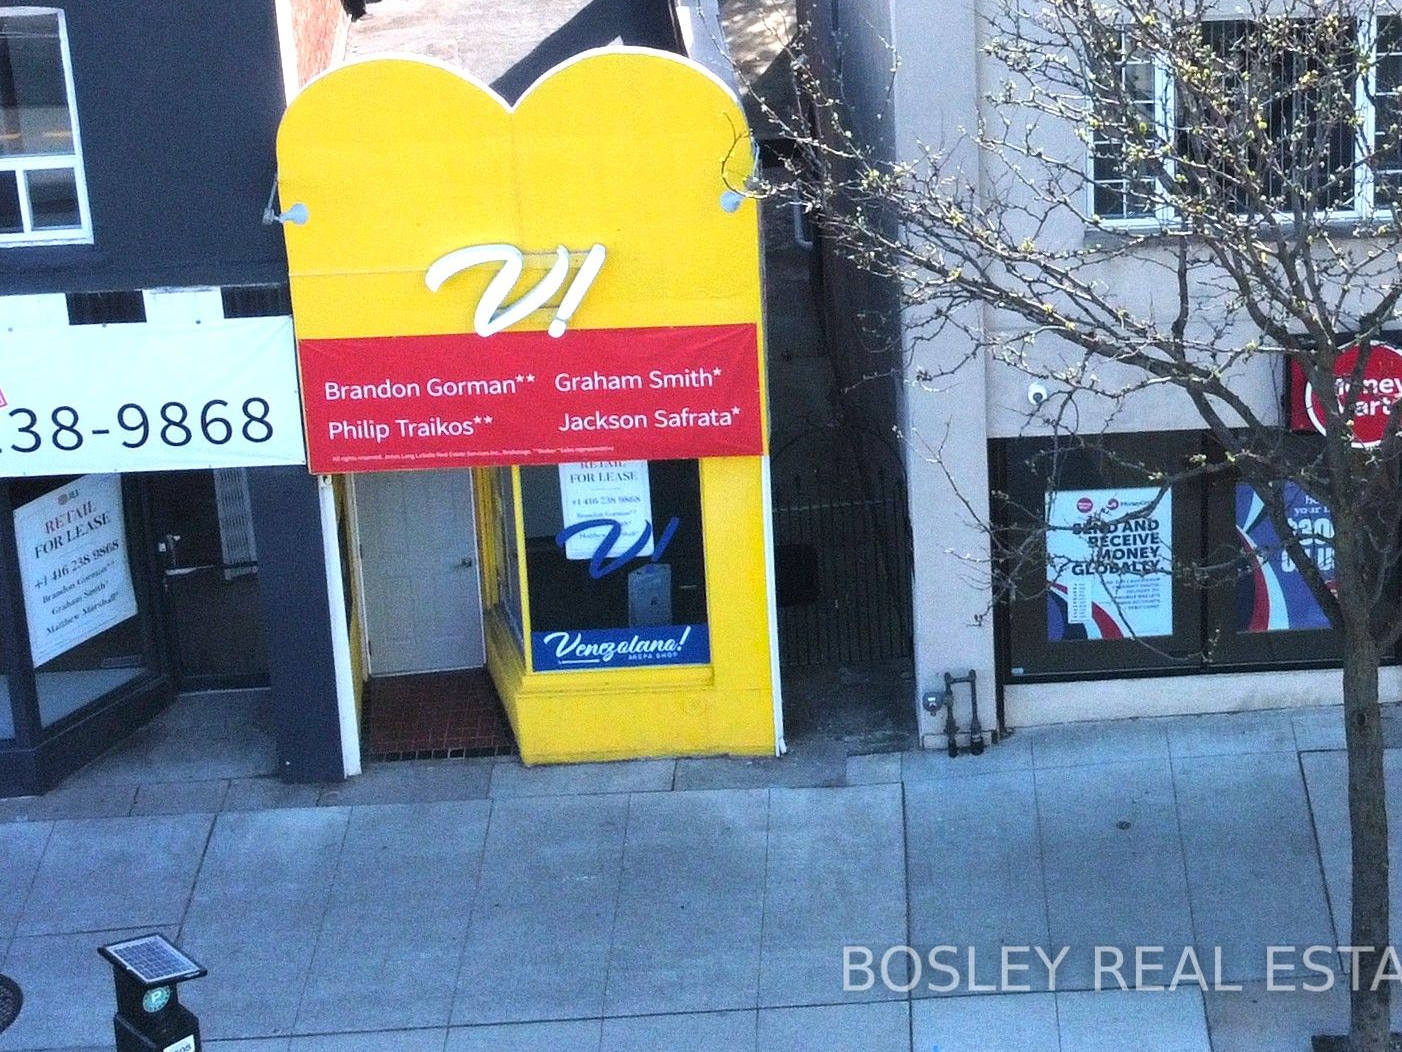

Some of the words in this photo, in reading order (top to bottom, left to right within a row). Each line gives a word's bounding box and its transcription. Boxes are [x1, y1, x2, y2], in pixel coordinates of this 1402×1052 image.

[324, 379, 420, 401] Brandon
[554, 372, 642, 393] Graham
[0, 397, 274, 453] 38-9868
[328, 419, 390, 443] Philip
[558, 410, 647, 432] Jackson
[570, 473, 595, 484] FOR
[599, 471, 638, 482] LEASE
[44, 500, 96, 534] RETAIL
[1122, 519, 1160, 533] AND
[34, 534, 64, 559] FOR
[66, 513, 112, 542] LEASE
[1088, 532, 1160, 548] RECEIVE
[1097, 546, 1160, 561] MONEY
[51, 565, 69, 583] 416
[71, 554, 91, 573] 238
[151, 990, 162, 1004] P
